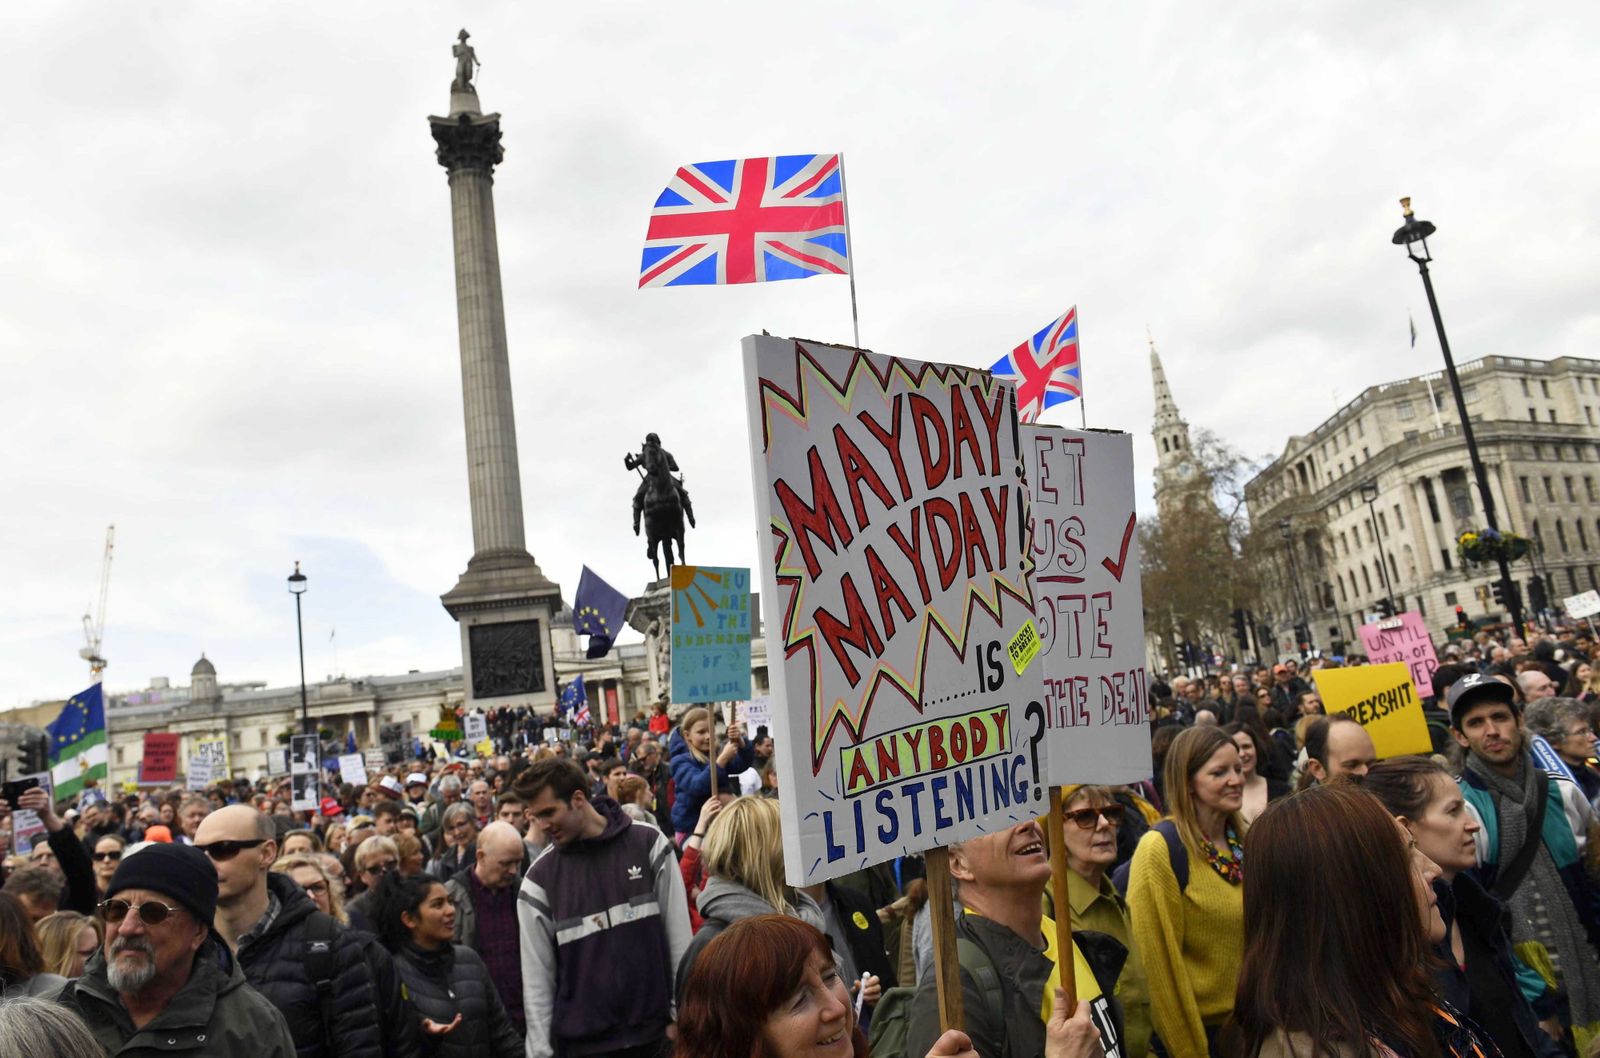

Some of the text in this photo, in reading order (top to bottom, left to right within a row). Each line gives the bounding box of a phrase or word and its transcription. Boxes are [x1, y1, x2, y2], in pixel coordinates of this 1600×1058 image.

[773, 384, 1022, 583] MAYDAY!
[1034, 435, 1085, 506] ET
[1031, 516, 1086, 574] US
[812, 485, 1028, 689] MAYDAY!
[1009, 624, 1031, 653] BOLLOCKS
[1018, 631, 1034, 653] BREXIT
[1038, 591, 1112, 659] OTE
[1367, 626, 1428, 652] UNTIL
[1412, 644, 1426, 658] OF
[1338, 681, 1412, 725] REXSHIT
[847, 708, 1009, 790] ANYBODY
